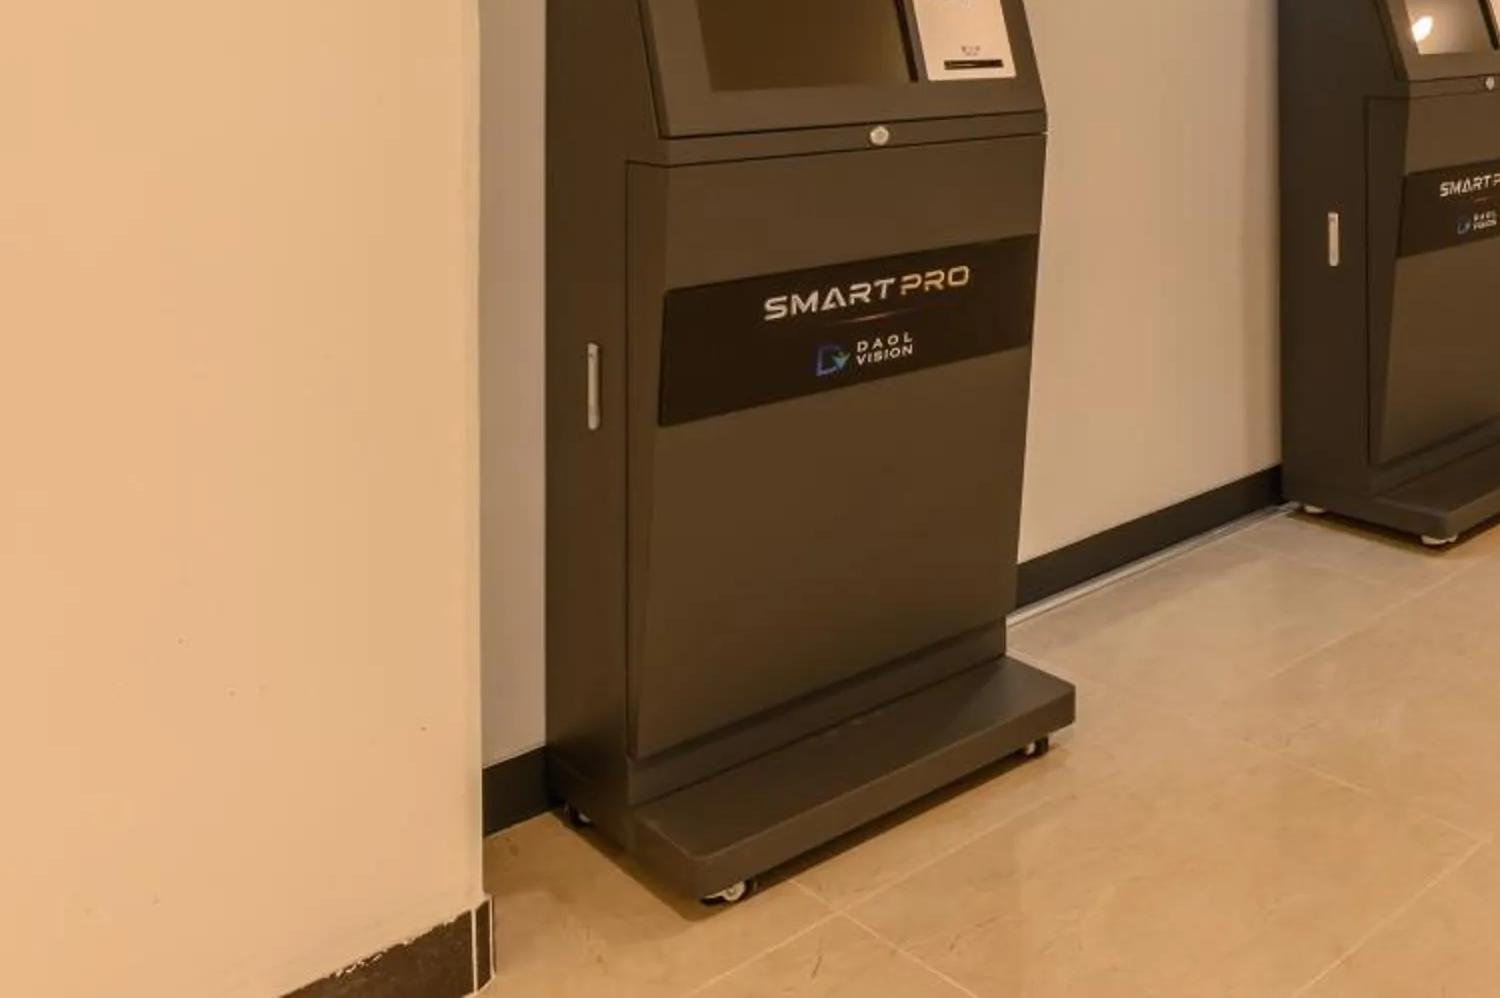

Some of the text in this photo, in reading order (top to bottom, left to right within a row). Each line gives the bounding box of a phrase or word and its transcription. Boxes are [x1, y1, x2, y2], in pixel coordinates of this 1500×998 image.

[1439, 174, 1492, 198] SMART
[764, 265, 970, 321] SMART PRO
[856, 332, 913, 353] DAOL
[855, 343, 914, 366] VISION
